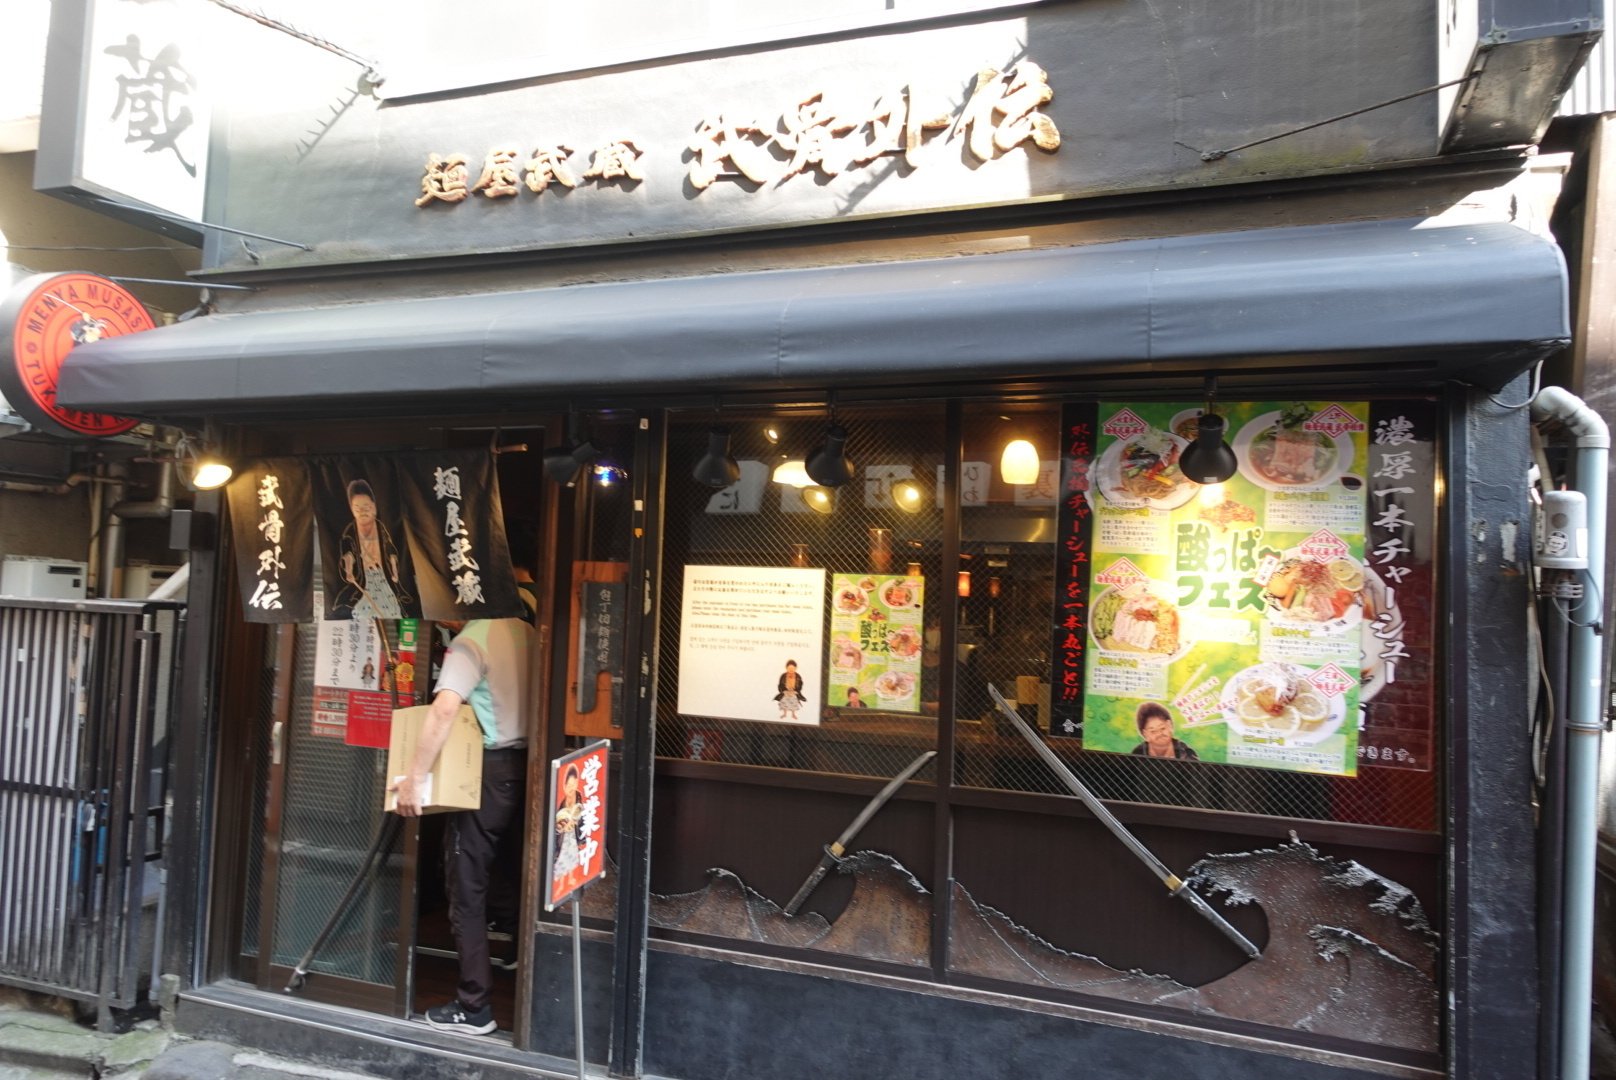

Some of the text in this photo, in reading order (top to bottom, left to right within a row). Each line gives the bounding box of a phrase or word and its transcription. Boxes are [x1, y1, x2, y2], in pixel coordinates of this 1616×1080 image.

[26, 283, 149, 335] MENYA MUSAS
[248, 474, 286, 610] 武骨外伝
[433, 466, 487, 608] 麺屋武蔵
[1175, 574, 1268, 613] フェス
[1372, 415, 1417, 685] 濃厚一本チャーシュー
[579, 754, 603, 877] 営業中
